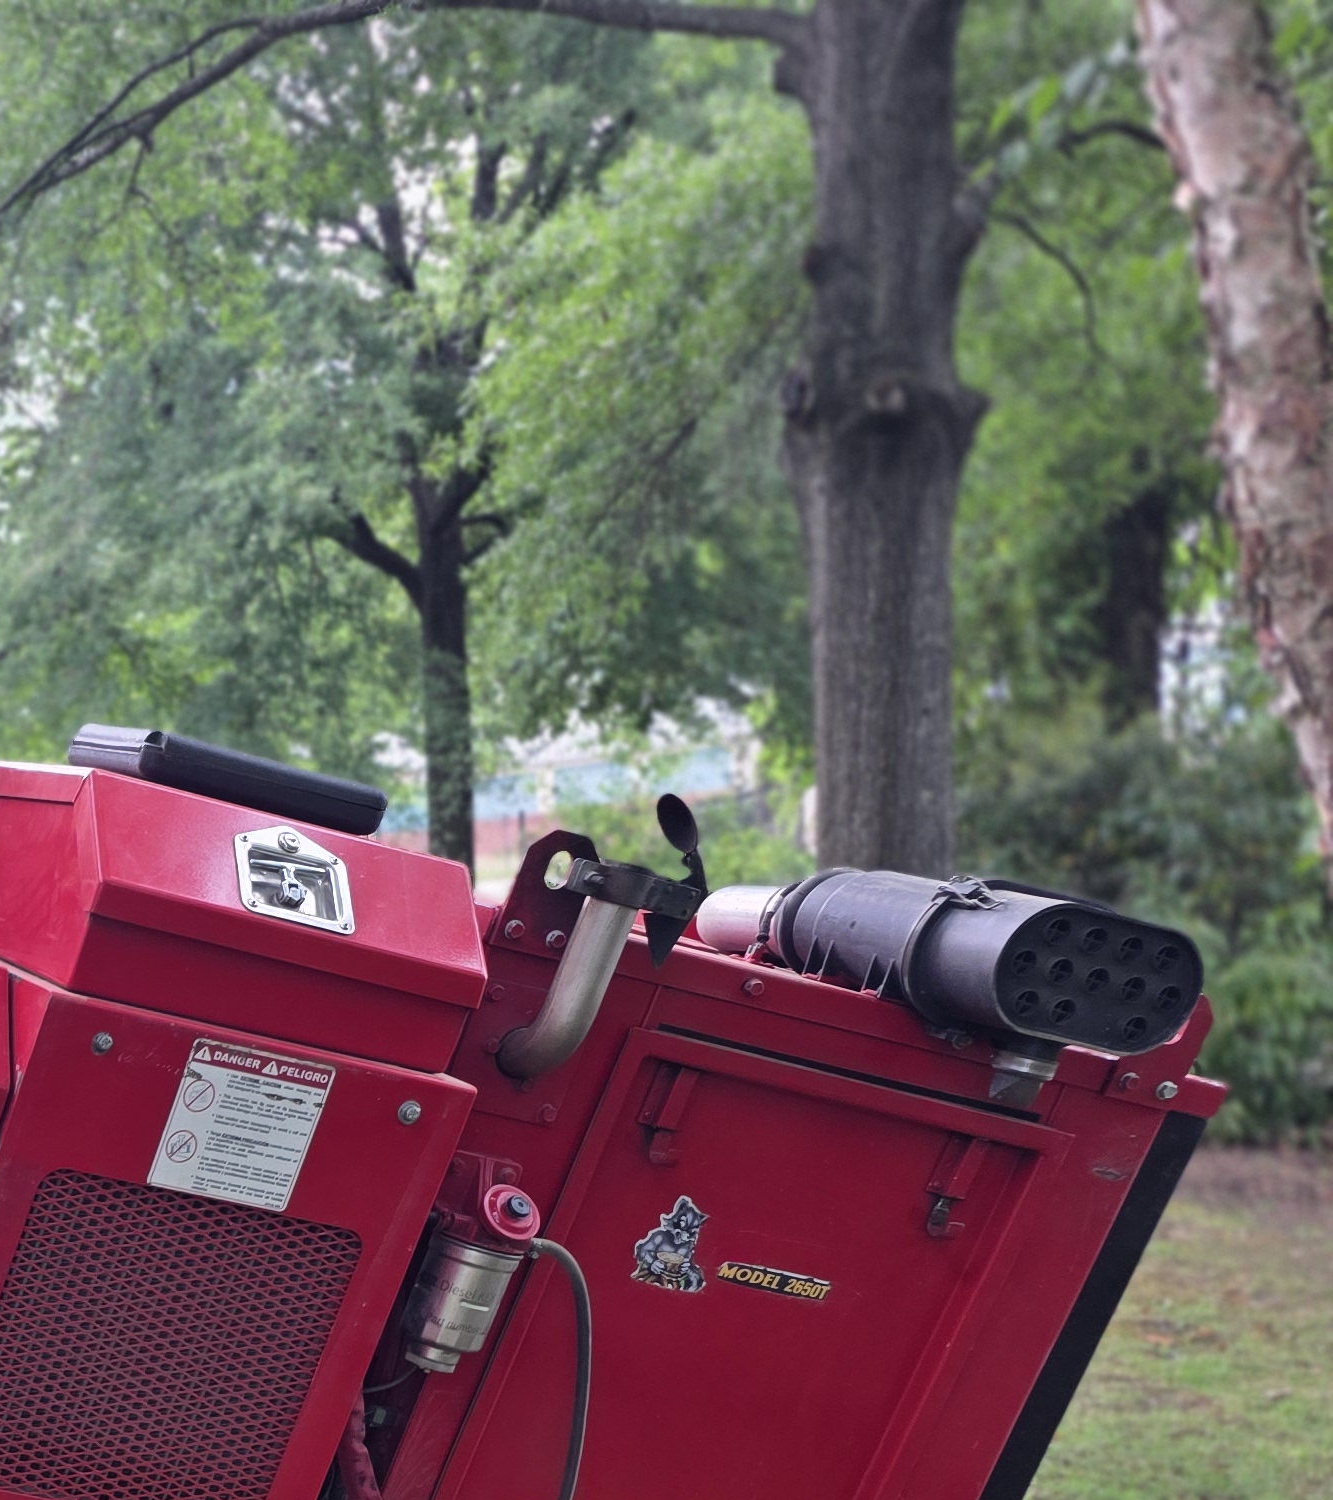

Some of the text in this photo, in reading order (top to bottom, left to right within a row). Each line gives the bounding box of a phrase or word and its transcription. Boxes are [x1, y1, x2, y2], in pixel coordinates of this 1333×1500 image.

[213, 1050, 329, 1084] DANGER PELIGRO
[439, 1280, 478, 1300] Diesel
[718, 1263, 831, 1300] MODEL 2650T
